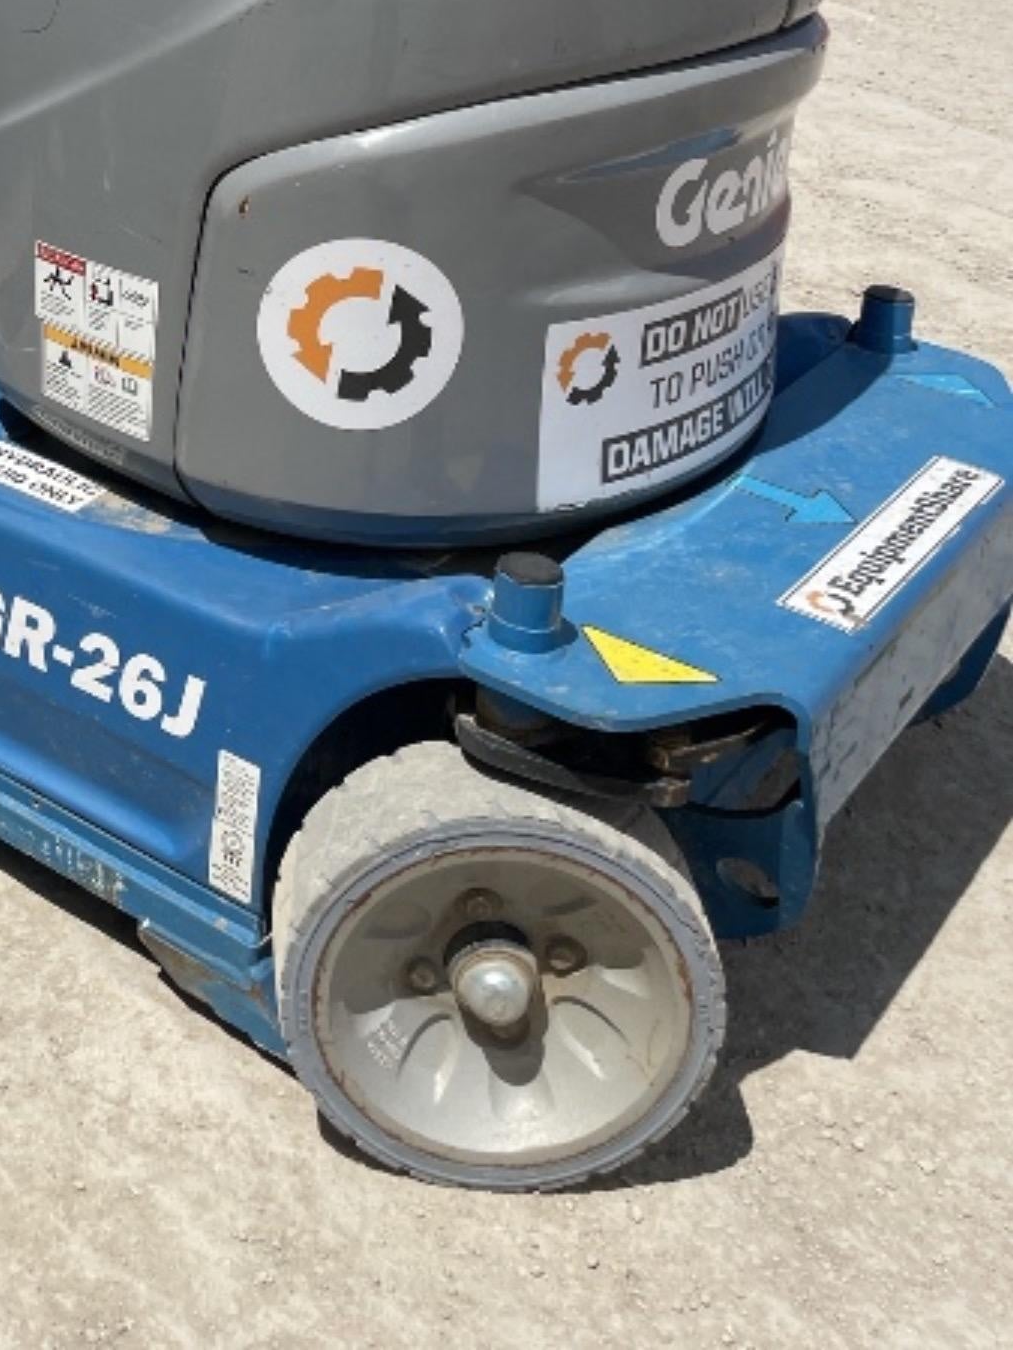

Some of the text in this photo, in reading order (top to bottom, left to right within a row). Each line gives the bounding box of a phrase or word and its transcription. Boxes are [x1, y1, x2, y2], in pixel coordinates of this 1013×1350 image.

[645, 318, 687, 361] DO
[691, 293, 741, 346] NOT
[649, 370, 685, 408] TO
[689, 336, 745, 396] PUSH
[606, 402, 725, 478] DAMAGE
[827, 469, 980, 596] EquipmentShare
